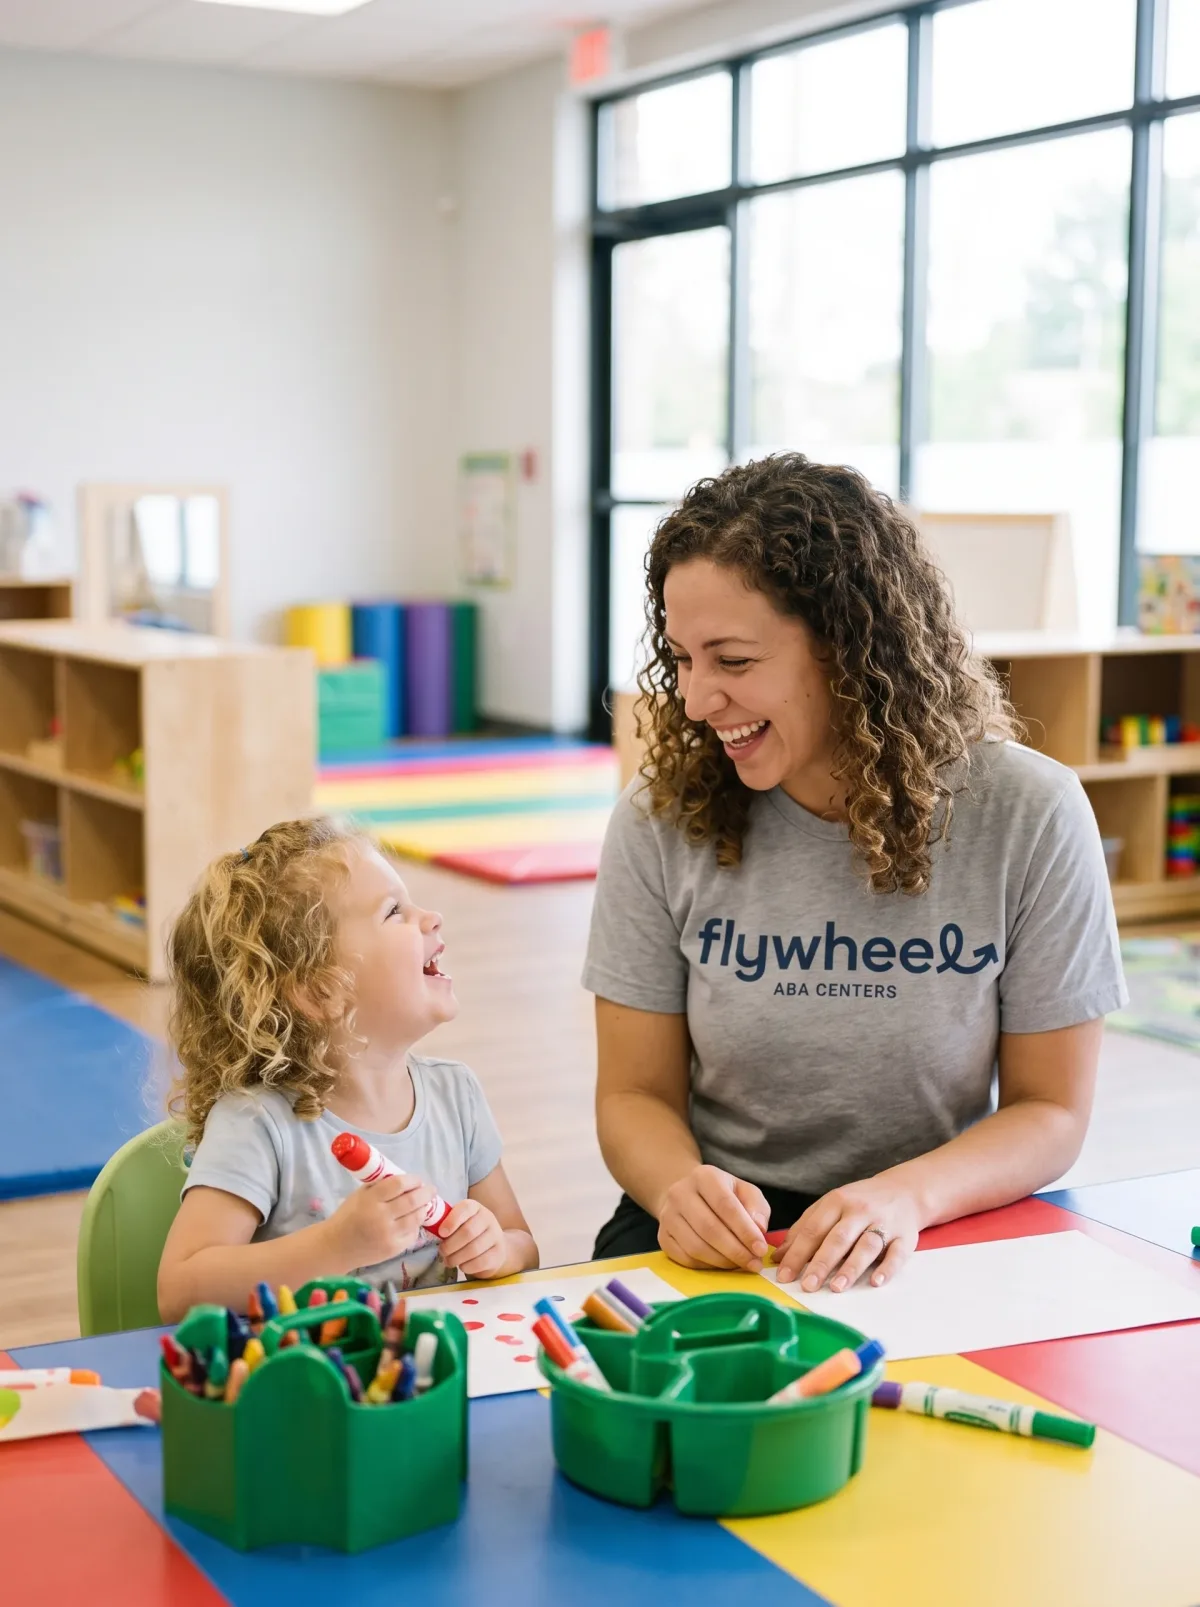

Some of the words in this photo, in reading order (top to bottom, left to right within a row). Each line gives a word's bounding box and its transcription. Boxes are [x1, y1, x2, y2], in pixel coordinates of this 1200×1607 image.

[698, 918, 999, 982] flywheel
[773, 982, 809, 997] ABA
[815, 983, 898, 999] CENTERS
